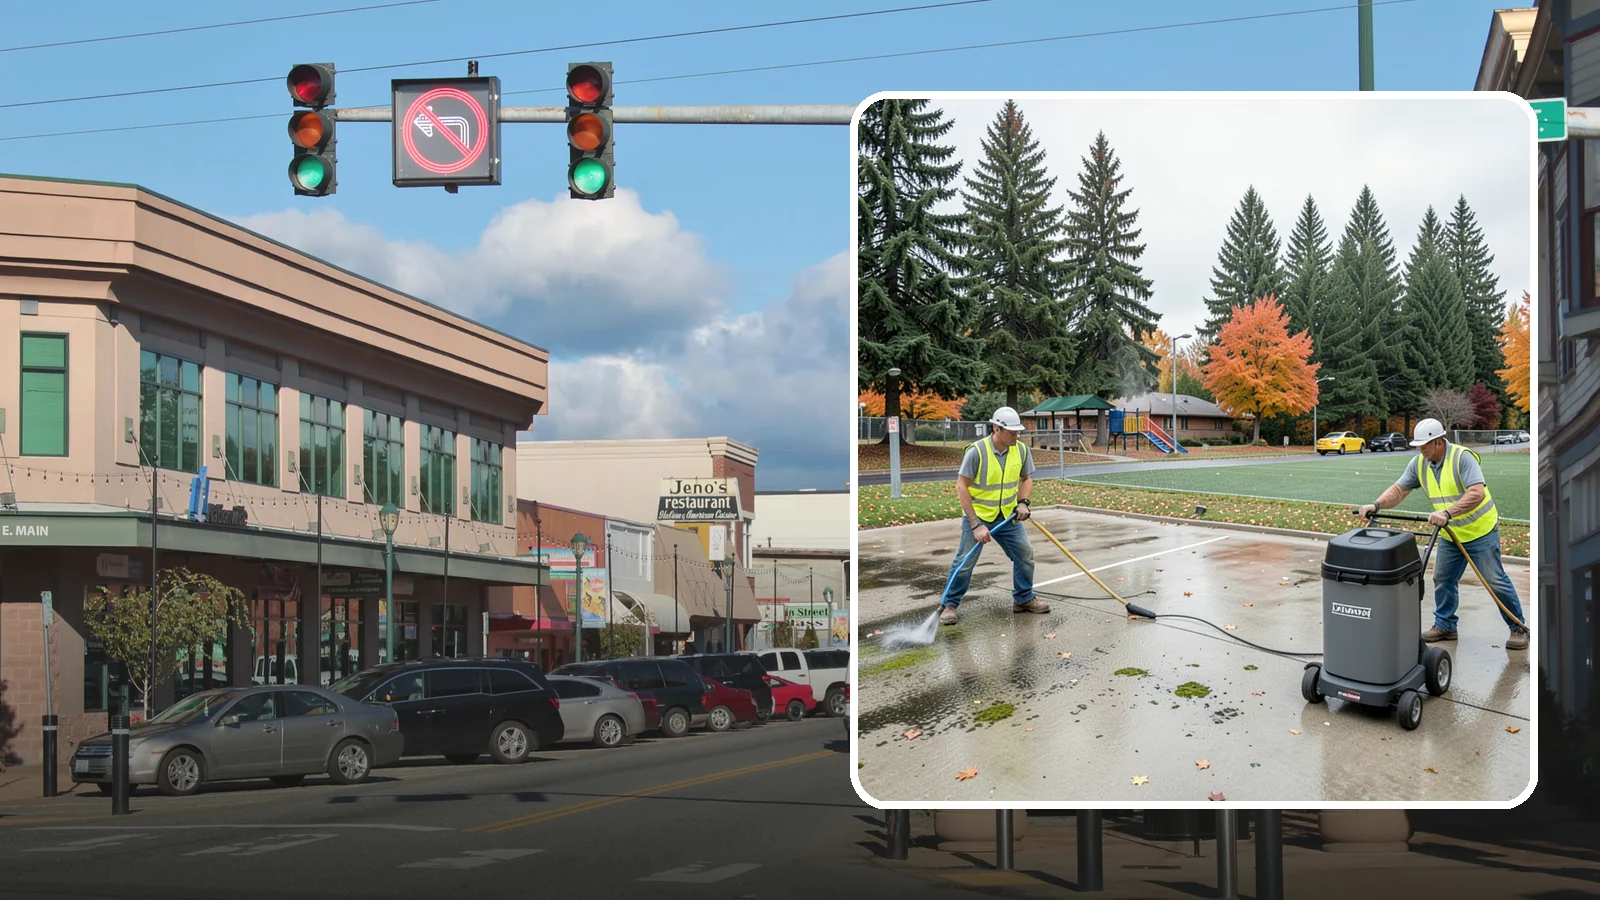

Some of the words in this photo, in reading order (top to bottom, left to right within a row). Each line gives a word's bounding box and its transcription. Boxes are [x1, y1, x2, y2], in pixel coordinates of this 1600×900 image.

[670, 480, 727, 495] Jeno's
[665, 496, 731, 509] restaurant
[659, 510, 681, 520] Italian
[686, 509, 715, 519] American
[715, 510, 737, 519] Cuisine
[2, 525, 13, 536] E.
[15, 525, 49, 536] MAIN
[797, 607, 829, 617] Street
